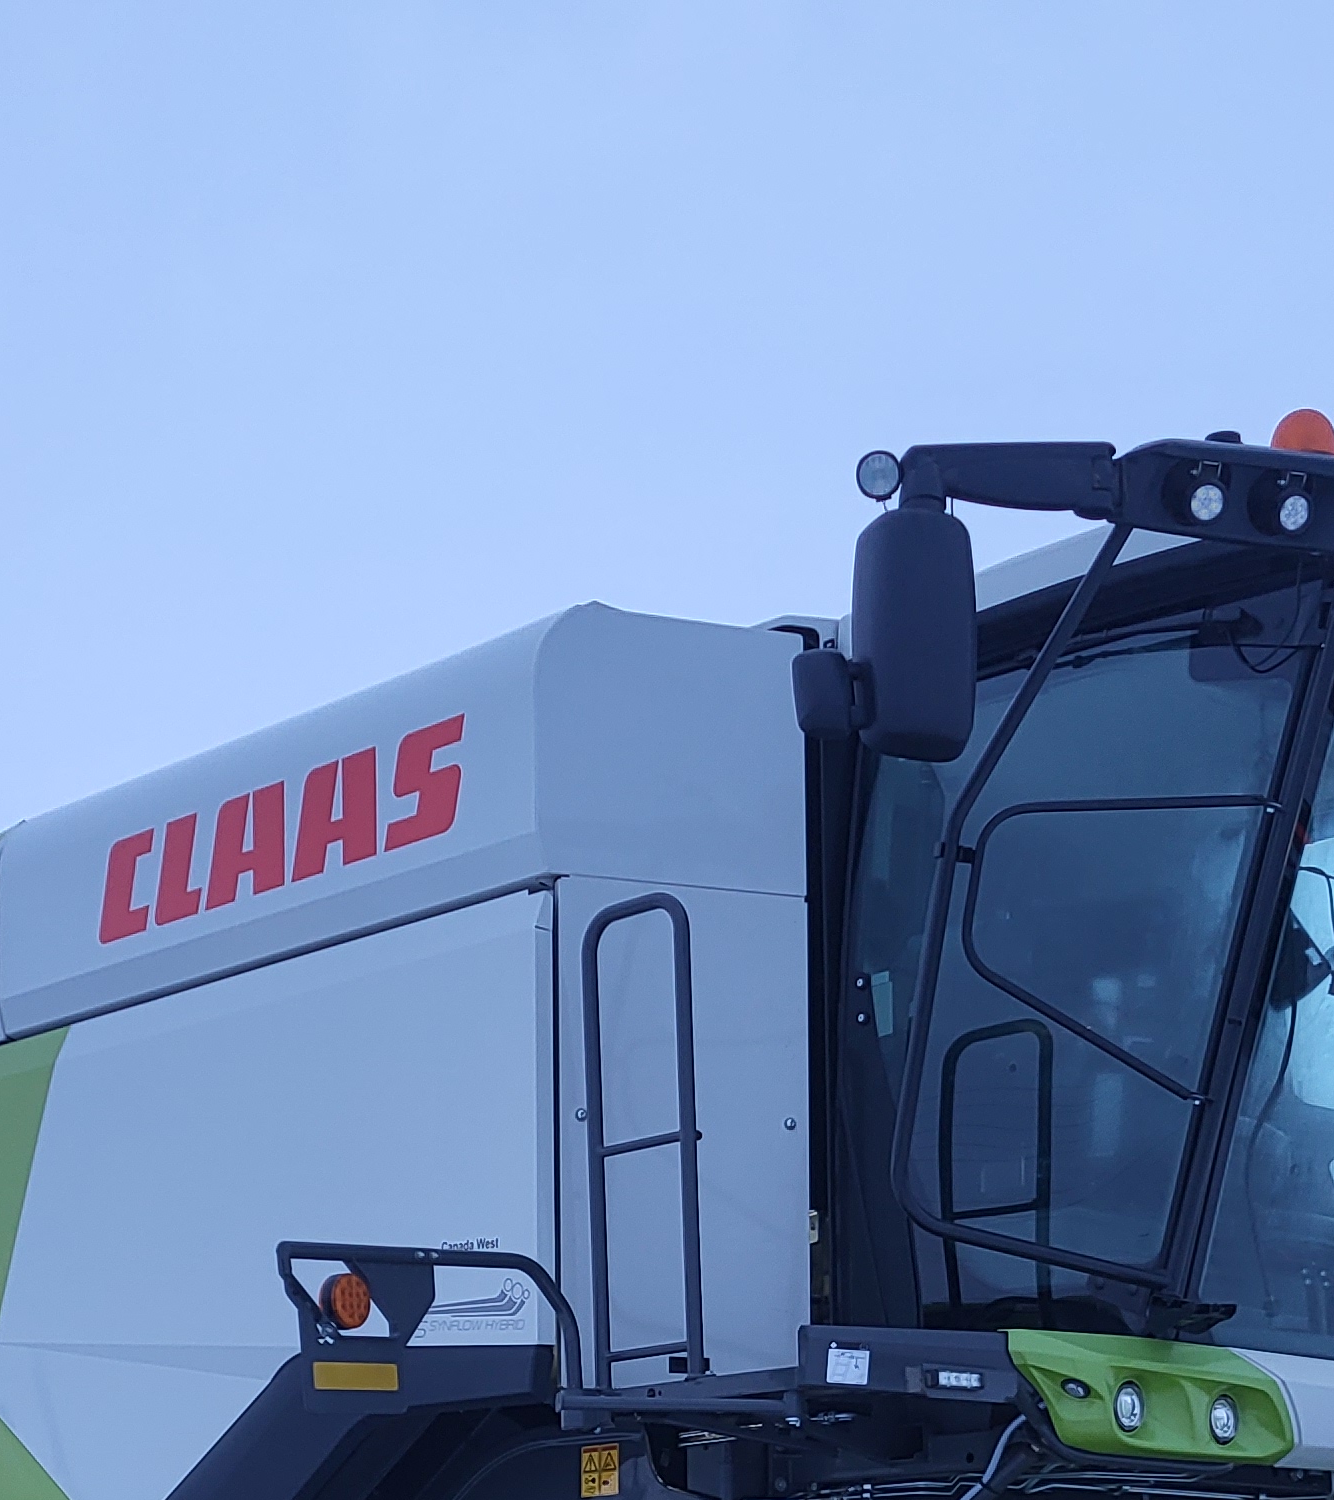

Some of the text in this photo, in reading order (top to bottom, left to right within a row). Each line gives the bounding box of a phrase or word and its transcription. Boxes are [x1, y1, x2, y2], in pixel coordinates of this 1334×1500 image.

[99, 713, 465, 944] CLAAS
[441, 1237, 501, 1251] Canada West
[429, 1321, 484, 1332] SYNFLOW
[486, 1319, 526, 1331] HYBRID
